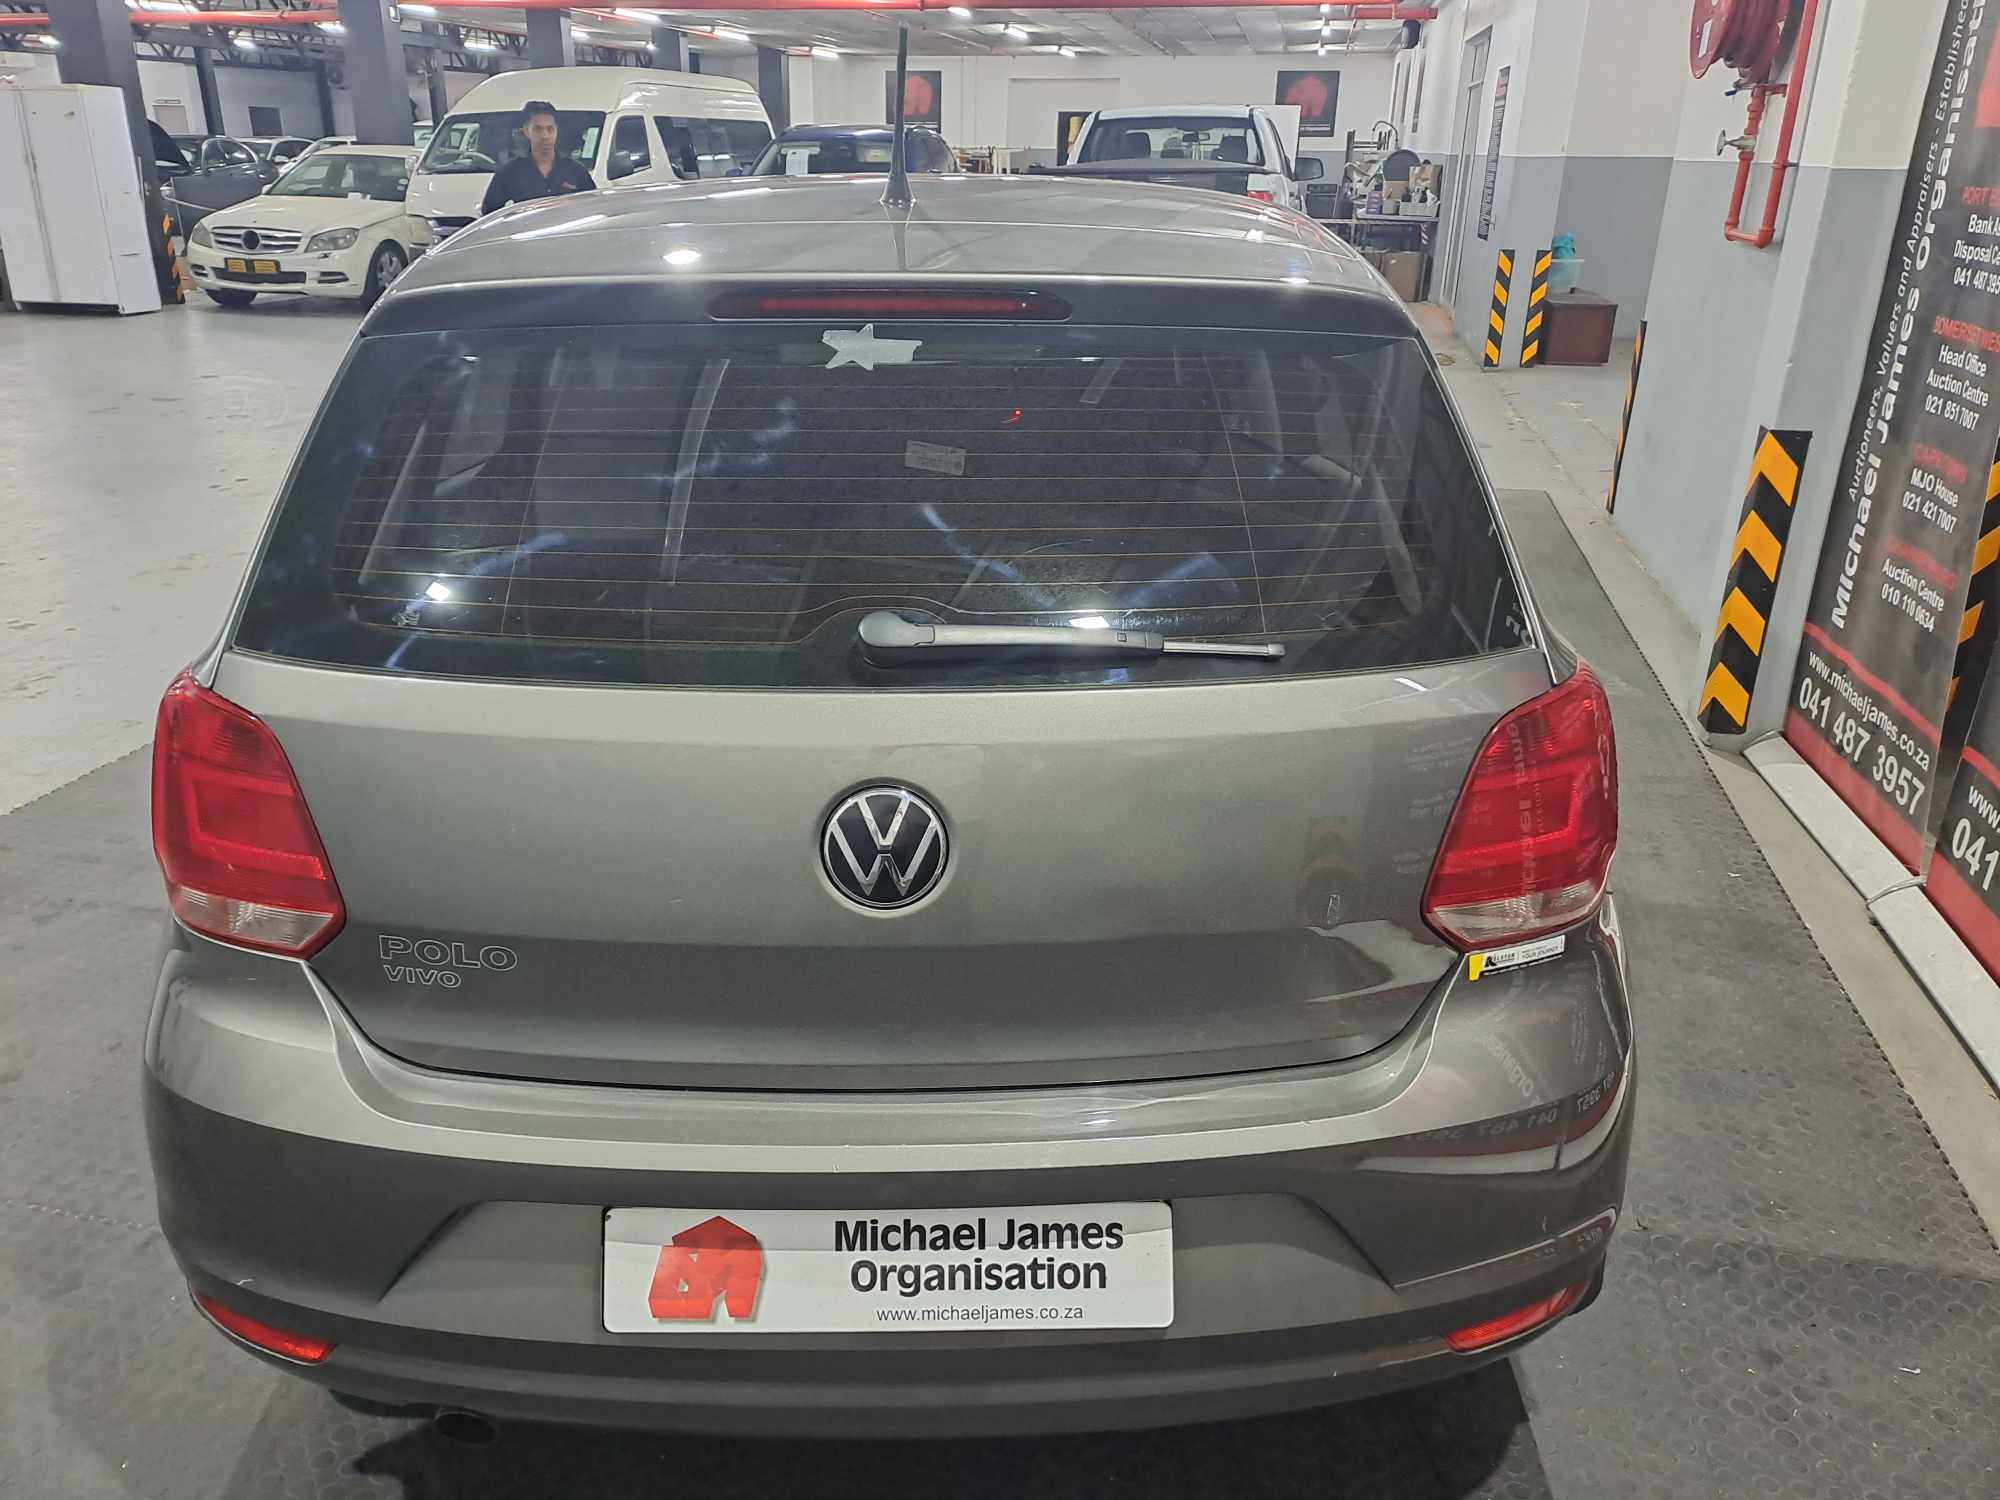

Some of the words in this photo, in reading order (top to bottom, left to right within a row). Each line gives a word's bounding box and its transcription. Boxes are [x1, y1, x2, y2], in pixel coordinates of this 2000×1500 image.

[1968, 214, 1993, 235] Bank
[1877, 303, 1901, 375] Valuers
[1898, 255, 1912, 297] and
[1907, 141, 1938, 253] Appraisers
[1953, 240, 1993, 264] Disposal
[1953, 267, 1972, 287] 041
[1973, 270, 1988, 291] 487
[1938, 344, 1966, 368] Head
[1965, 352, 1987, 377] Office
[1926, 368, 1963, 395] Auction
[1962, 380, 1989, 407] Centre
[1925, 394, 1943, 415] 021
[1944, 400, 1960, 422] 851
[1959, 407, 1980, 431] 7007
[1831, 453, 1882, 629] Michael
[1876, 288, 1920, 445] James
[1910, 467, 1936, 492] MJO
[1934, 478, 1959, 508] House
[1902, 491, 1922, 513] 021
[1922, 500, 1938, 522] 421
[1936, 508, 1958, 534] 7007
[1882, 558, 1918, 592] Auction
[1917, 579, 1945, 612] Centre
[1881, 583, 1901, 606] 010
[1902, 594, 1917, 617] 110
[1914, 605, 1936, 633] 0634
[1808, 650, 1931, 773] www.michaeljames.co.za
[1798, 676, 1832, 730] 041
[1832, 711, 1871, 763] 487
[1871, 744, 1926, 816] 3957
[1951, 817, 2000, 892] 041
[379, 934, 518, 972] POLO
[382, 964, 462, 988] VIVO
[834, 1217, 986, 1252] Michael
[998, 1218, 1124, 1251] James
[850, 1257, 1107, 1298] Organisation
[876, 1304, 1084, 1324] www.michaeljames.co.za
